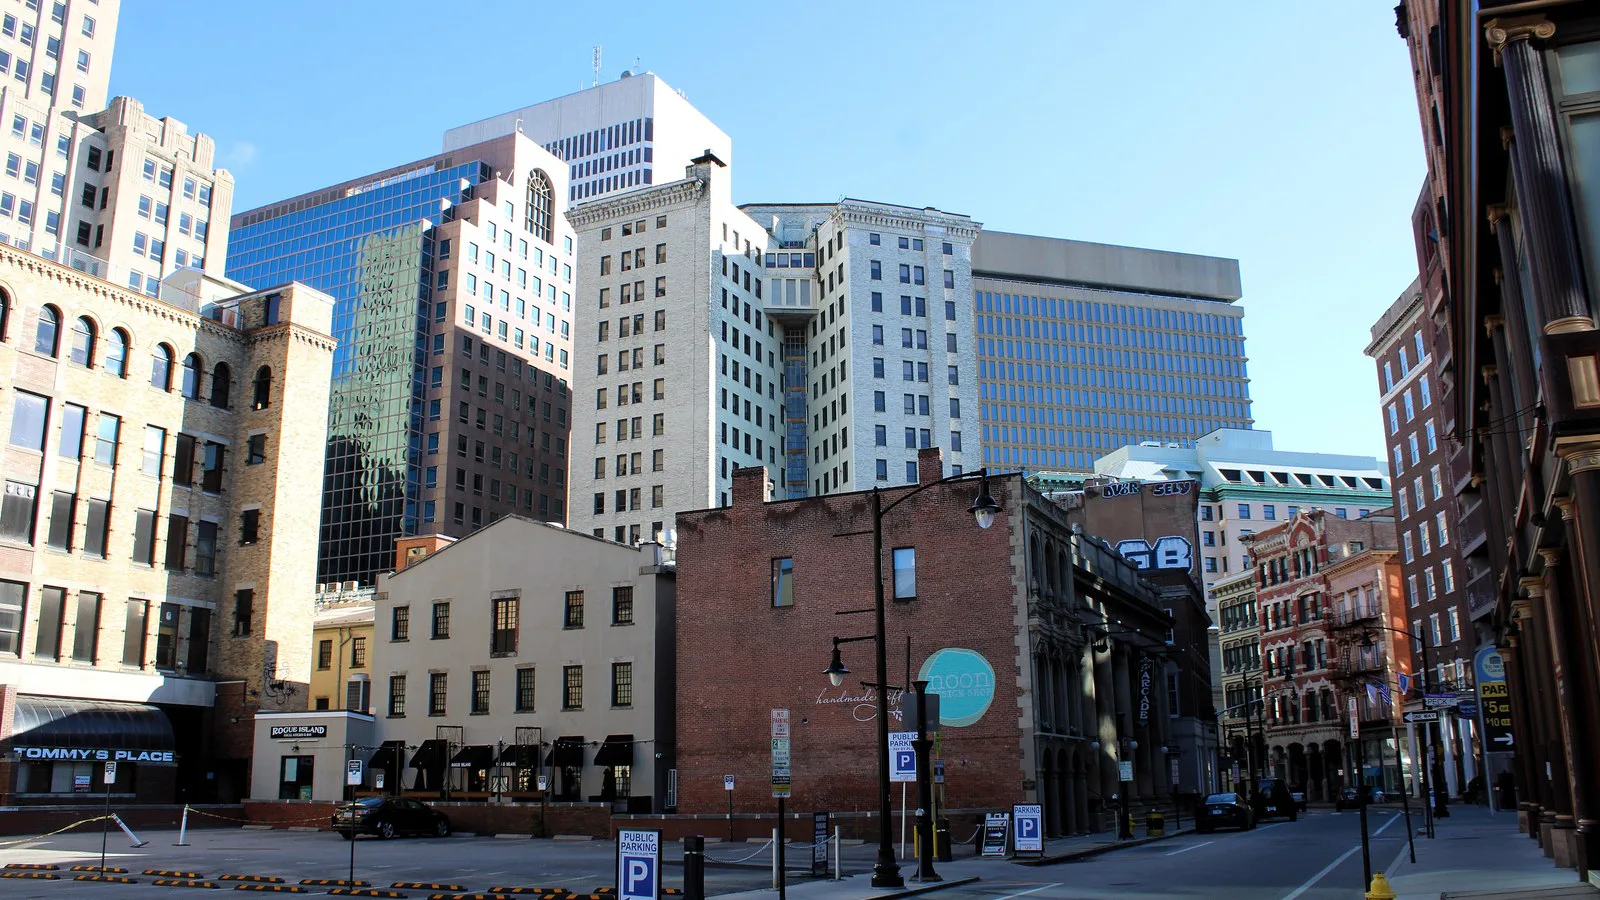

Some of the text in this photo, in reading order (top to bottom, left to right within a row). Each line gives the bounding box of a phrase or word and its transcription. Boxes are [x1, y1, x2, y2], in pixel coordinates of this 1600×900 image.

[928, 672, 990, 690] noon
[816, 688, 877, 704] handmade
[1140, 671, 1151, 719] ARCADE
[13, 747, 174, 762] TOMMY'S PLACE
[901, 755, 910, 767] P
[1023, 819, 1033, 837] P
[624, 833, 654, 842] PUBLIC
[621, 842, 657, 852] PARKING
[628, 861, 648, 892] P
